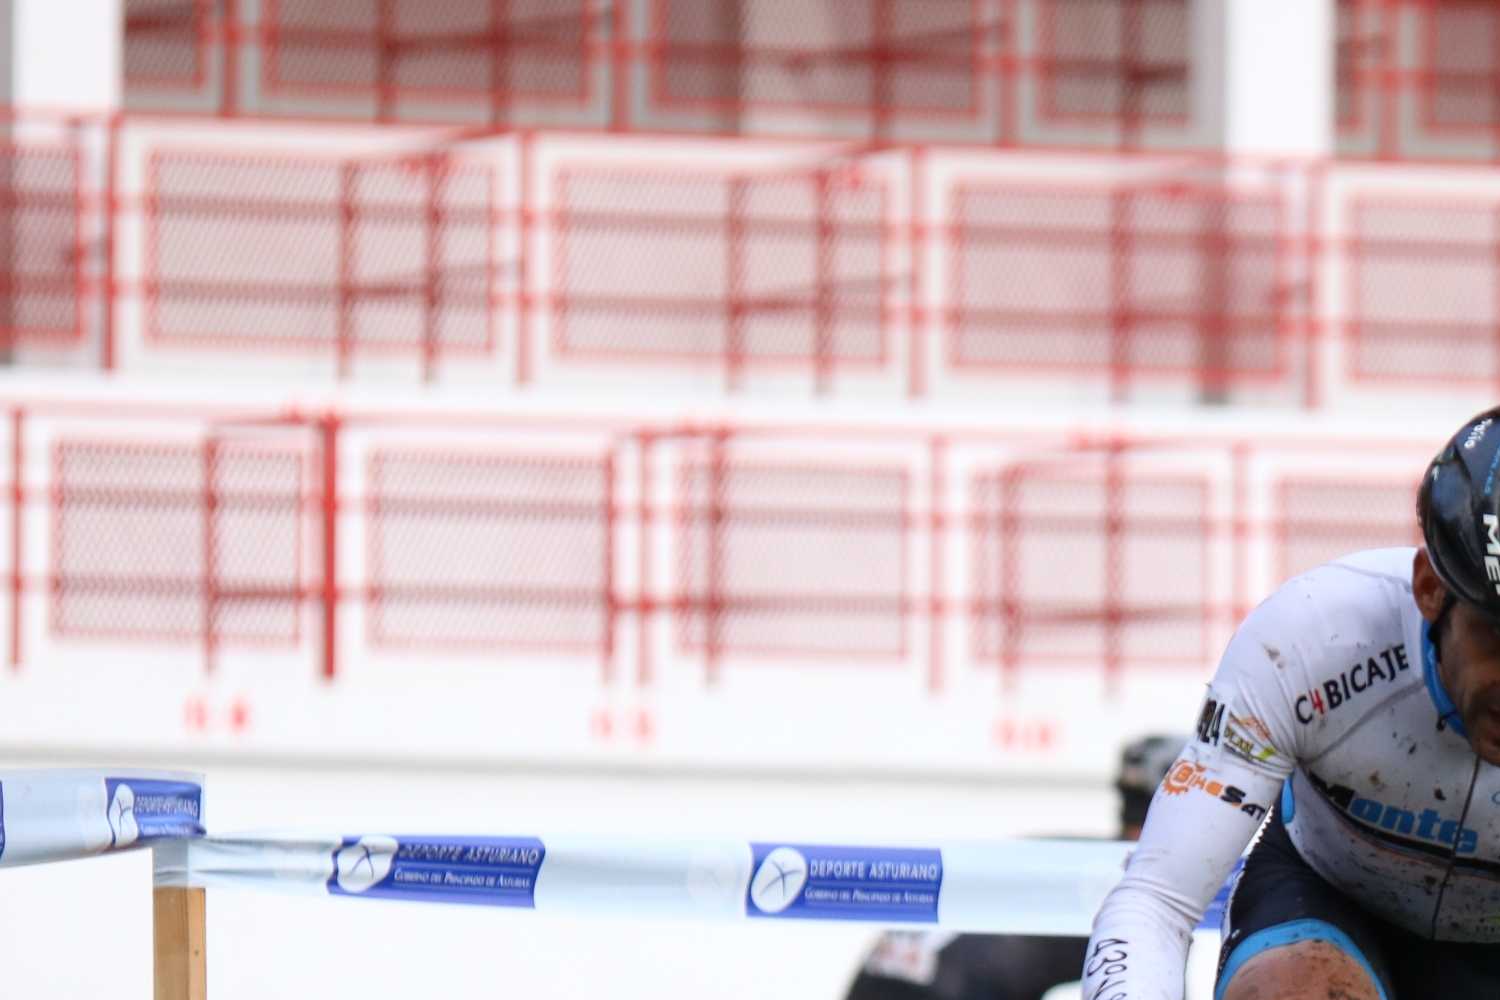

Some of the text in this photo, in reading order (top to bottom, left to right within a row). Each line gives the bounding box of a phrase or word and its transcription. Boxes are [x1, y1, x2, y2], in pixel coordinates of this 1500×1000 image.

[1295, 643, 1409, 725] C4BICAJE
[399, 843, 540, 866] DEPORTE ASTURIANO
[810, 859, 938, 880] DEPORTE ASTURIANO
